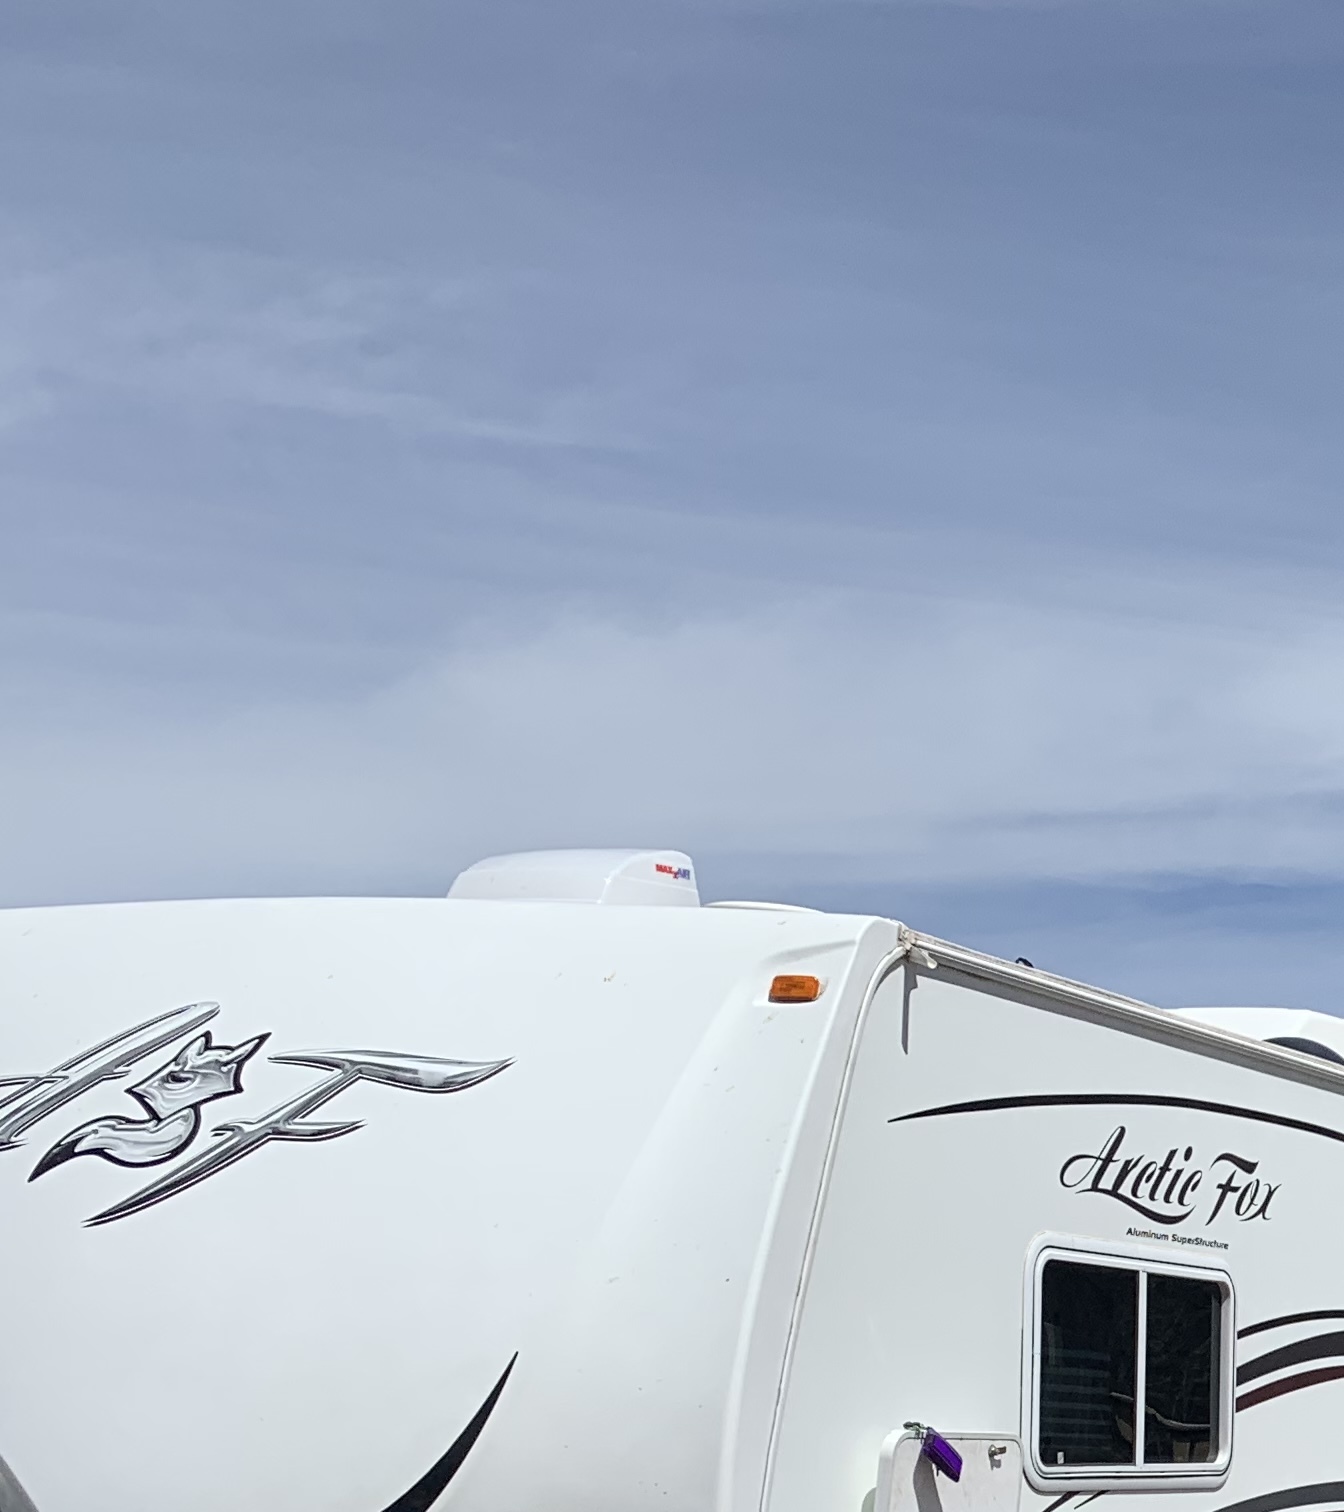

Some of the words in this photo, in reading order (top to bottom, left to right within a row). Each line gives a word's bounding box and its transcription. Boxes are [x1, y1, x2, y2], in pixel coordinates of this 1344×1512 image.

[1059, 1125, 1204, 1225] Arctic
[1205, 1152, 1282, 1226] Fox
[1125, 1227, 1169, 1242] Aluminum
